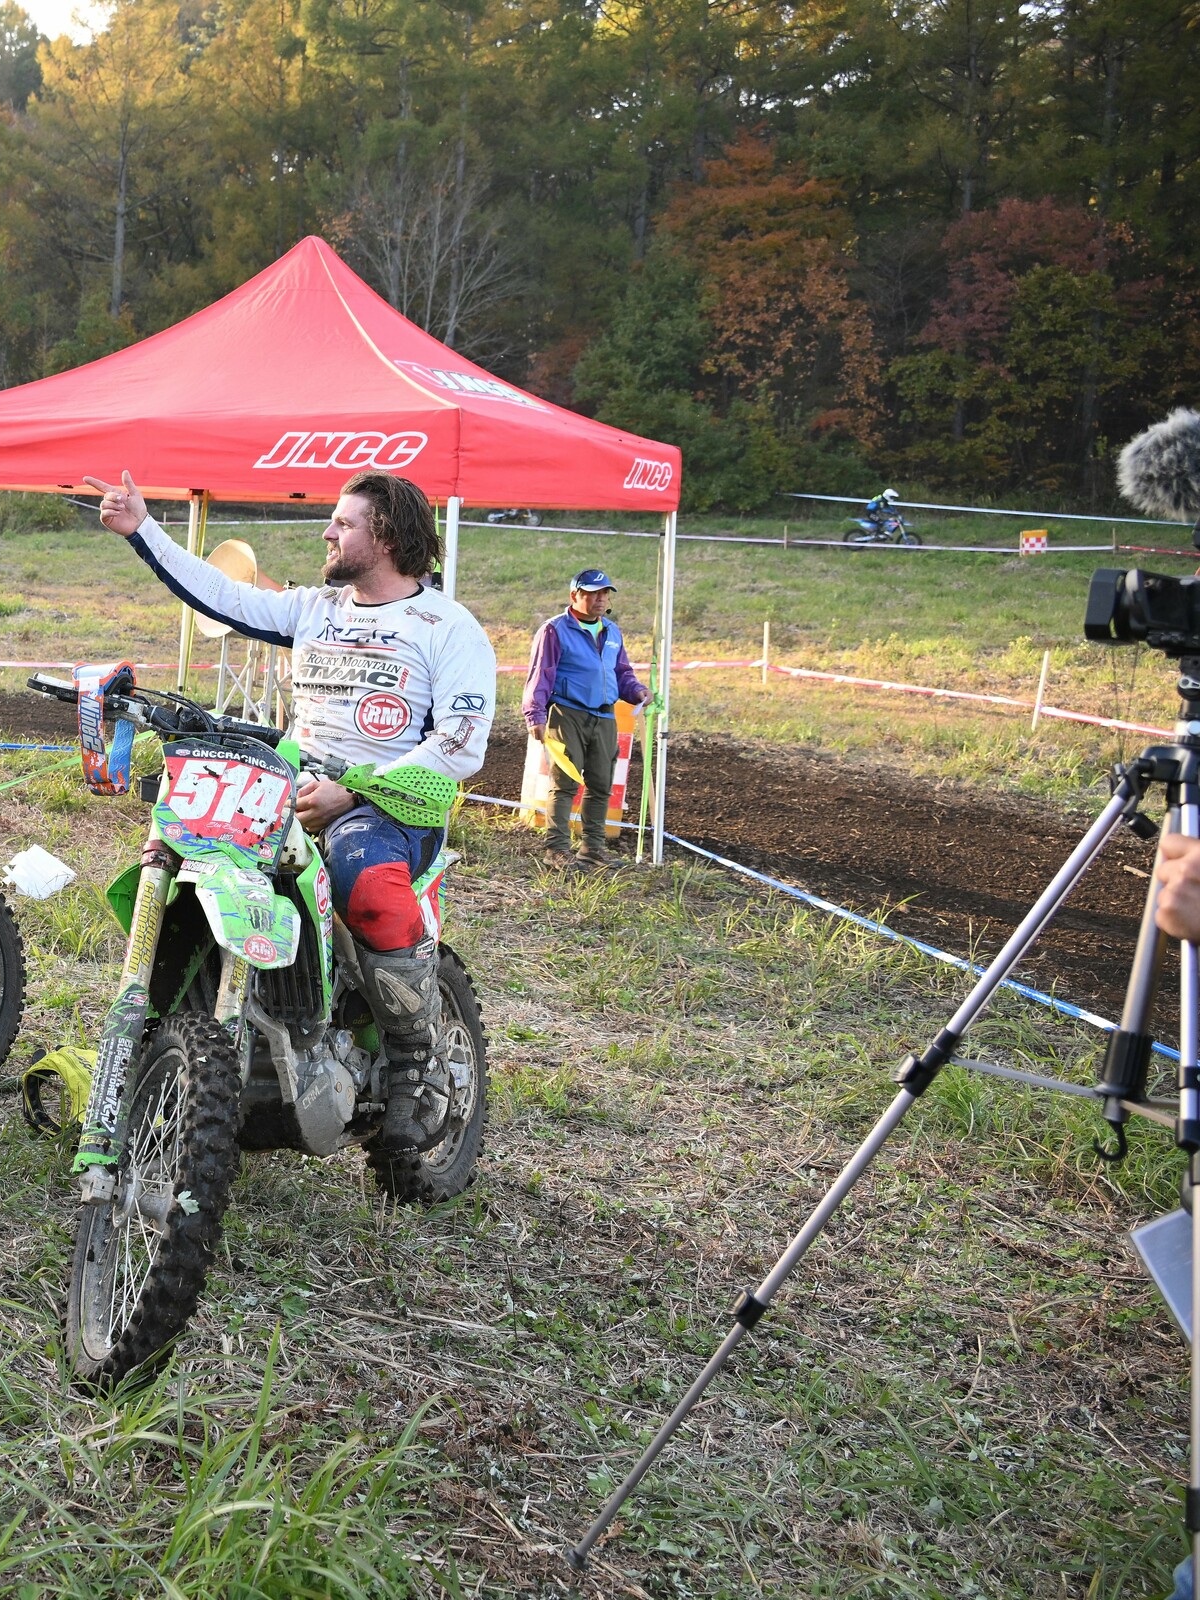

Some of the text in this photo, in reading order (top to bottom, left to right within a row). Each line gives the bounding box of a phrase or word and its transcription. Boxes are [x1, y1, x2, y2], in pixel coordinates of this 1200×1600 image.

[253, 431, 428, 470] JNCC
[623, 457, 673, 492] JNCC
[306, 653, 402, 675] ROCKY MOUNTAIN
[168, 760, 288, 837] 514
[106, 1037, 125, 1097] SUPERSTORE
